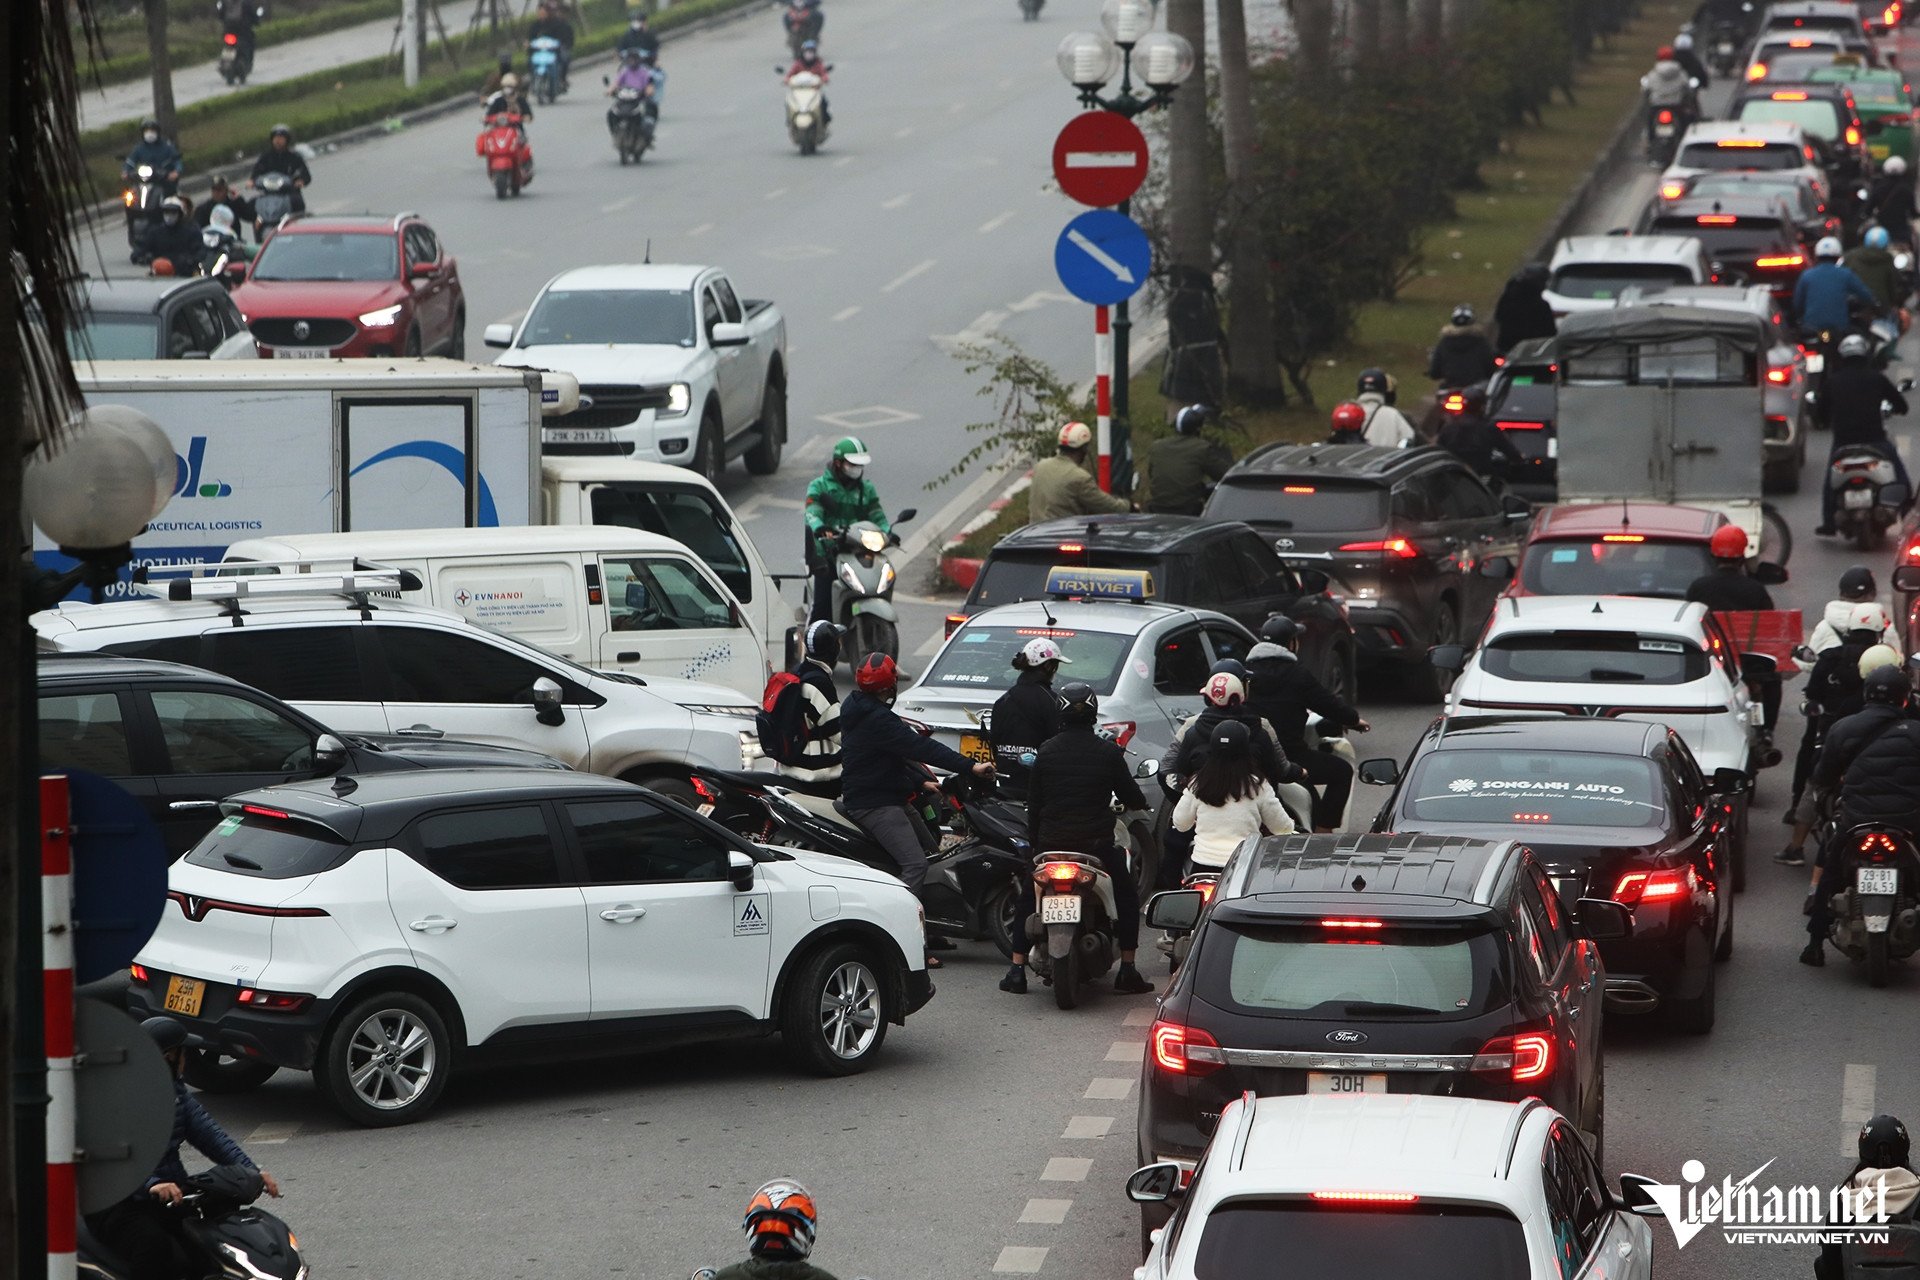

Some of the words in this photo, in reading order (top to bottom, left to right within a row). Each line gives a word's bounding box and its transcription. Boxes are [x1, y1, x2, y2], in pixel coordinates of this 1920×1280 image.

[209, 521, 262, 531] LOGISTICS
[474, 592, 523, 601] EVNHANOI
[1482, 781, 1569, 790] SONGANH
[1574, 783, 1625, 794] AUTO
[1048, 898, 1075, 909] 29-L5
[1044, 910, 1077, 921] 346.54
[1335, 1031, 1359, 1042] Ford
[1249, 1052, 1450, 1069] EVEREST
[1331, 1075, 1364, 1092] 30H
